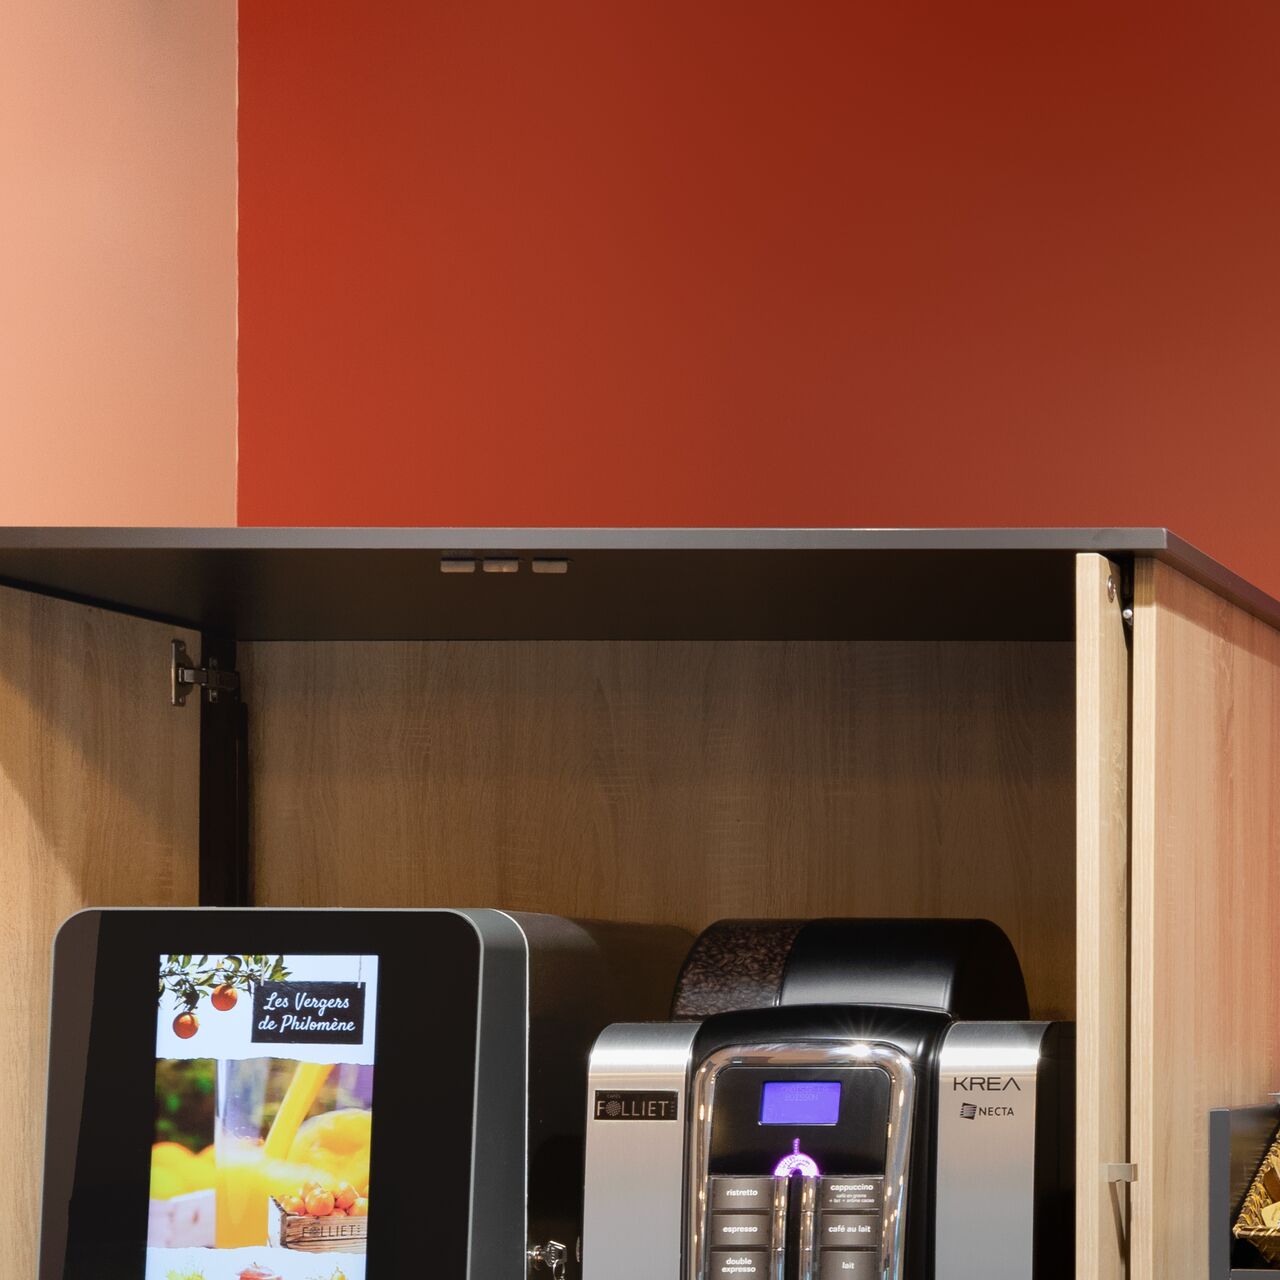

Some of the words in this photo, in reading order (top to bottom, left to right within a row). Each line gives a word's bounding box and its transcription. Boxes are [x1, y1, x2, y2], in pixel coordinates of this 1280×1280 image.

[263, 991, 289, 1011] Les
[295, 992, 350, 1016] Vergers
[258, 1015, 278, 1030] de
[279, 1014, 356, 1033] Philomène
[953, 1076, 1022, 1091] KREA
[978, 1106, 1015, 1117] NECTA
[726, 1188, 758, 1196] ristretto
[830, 1183, 874, 1192] cappuccino
[722, 1226, 758, 1234] espresso
[828, 1224, 845, 1233] café
[858, 1224, 871, 1233] lait
[726, 1257, 752, 1265] double
[842, 1261, 855, 1269] lait
[721, 1266, 757, 1274] expresso
